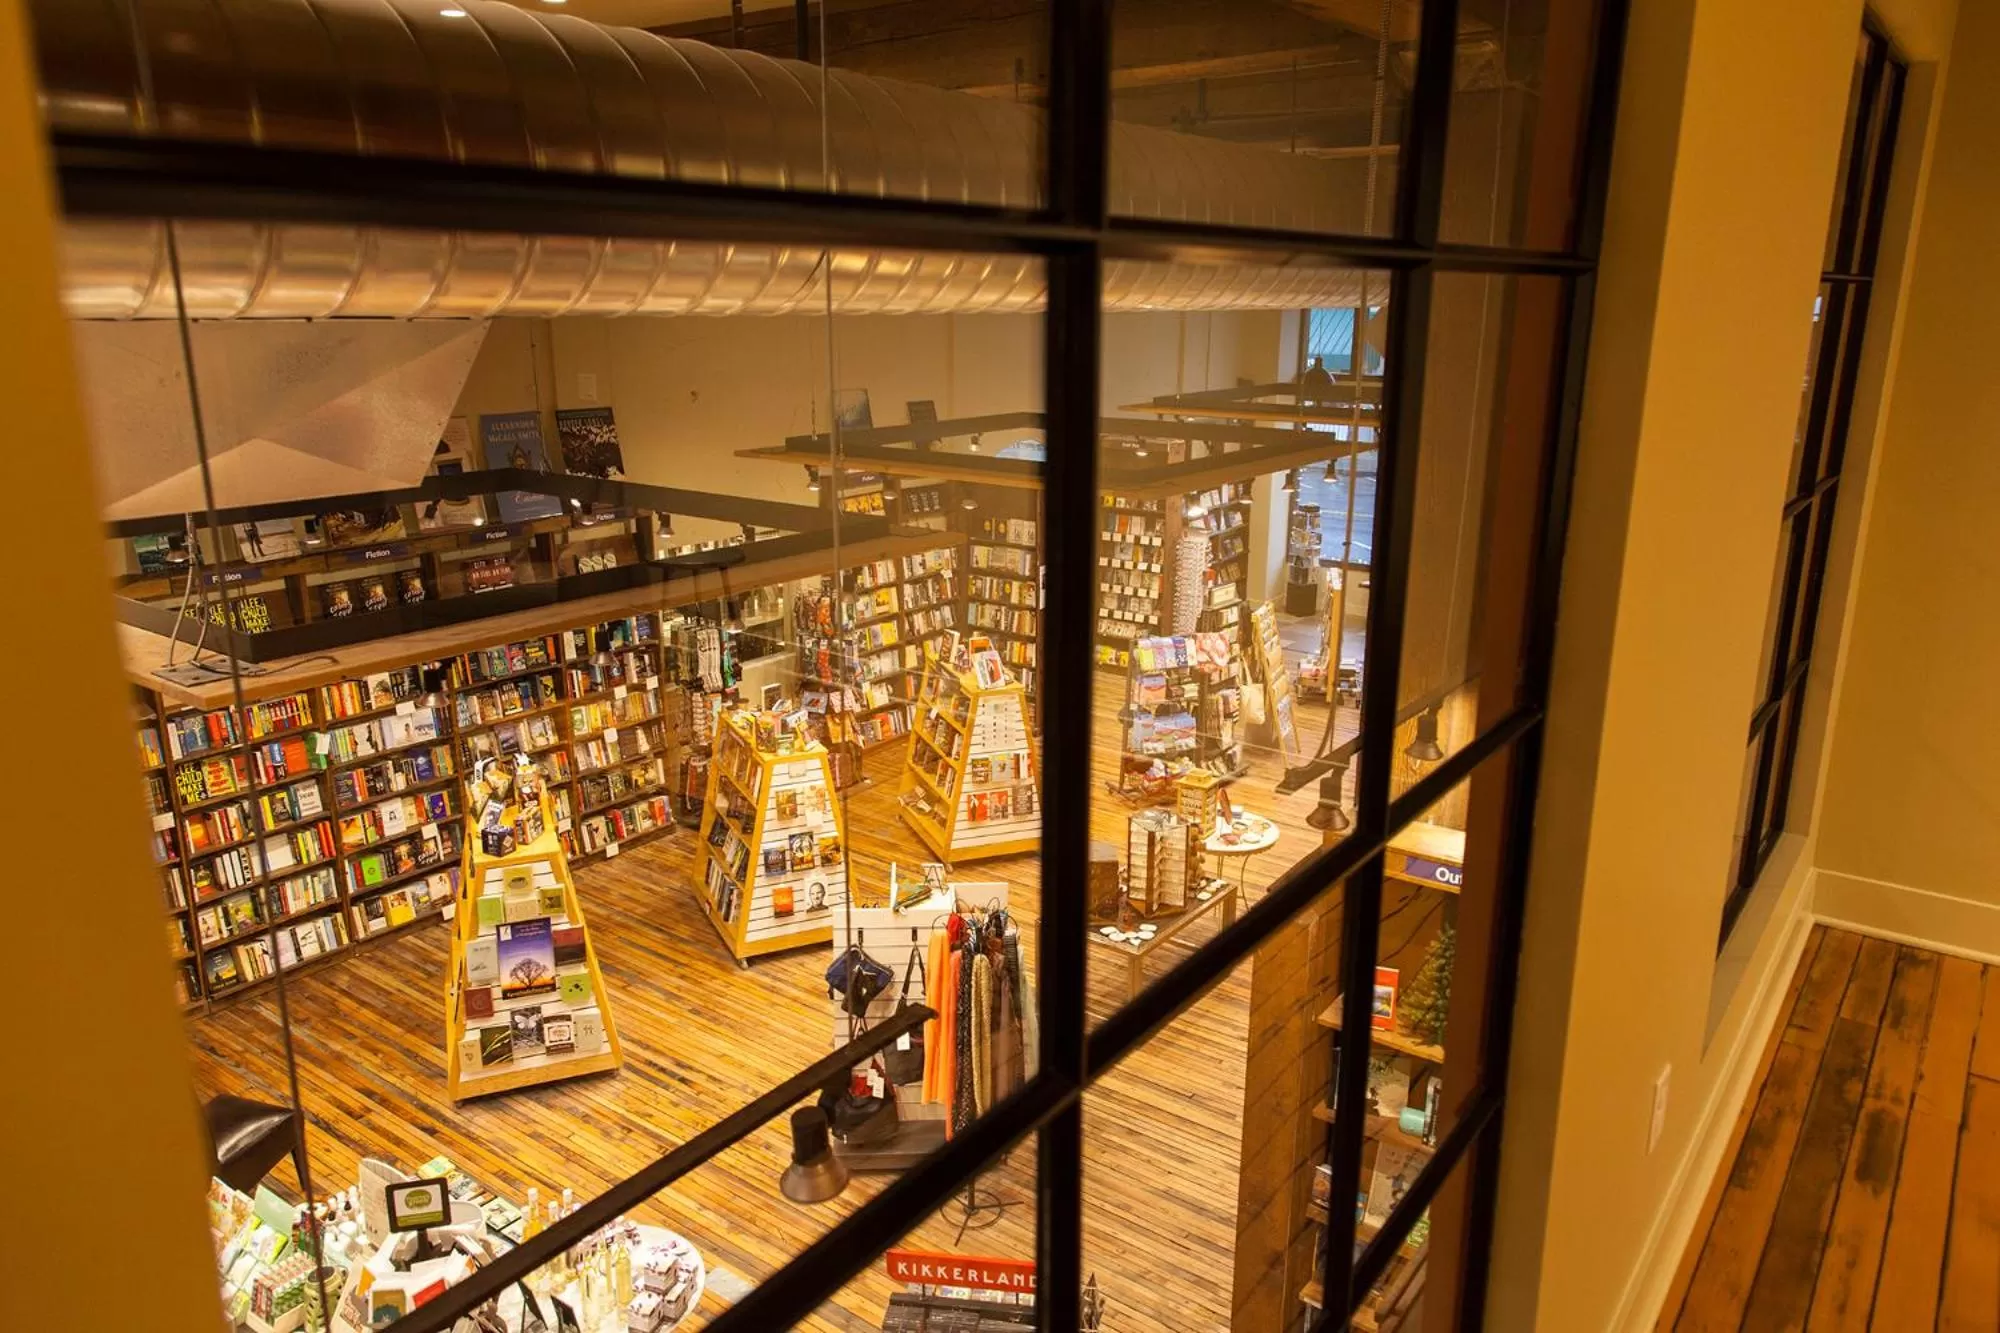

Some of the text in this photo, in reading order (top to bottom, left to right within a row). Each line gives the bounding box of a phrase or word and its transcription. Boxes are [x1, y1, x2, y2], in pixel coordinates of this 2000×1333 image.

[486, 530, 508, 539] Fiction
[365, 549, 391, 560] Fiction
[175, 771, 203, 787] CHILD
[179, 782, 204, 797] MAKE
[186, 792, 201, 804] ME
